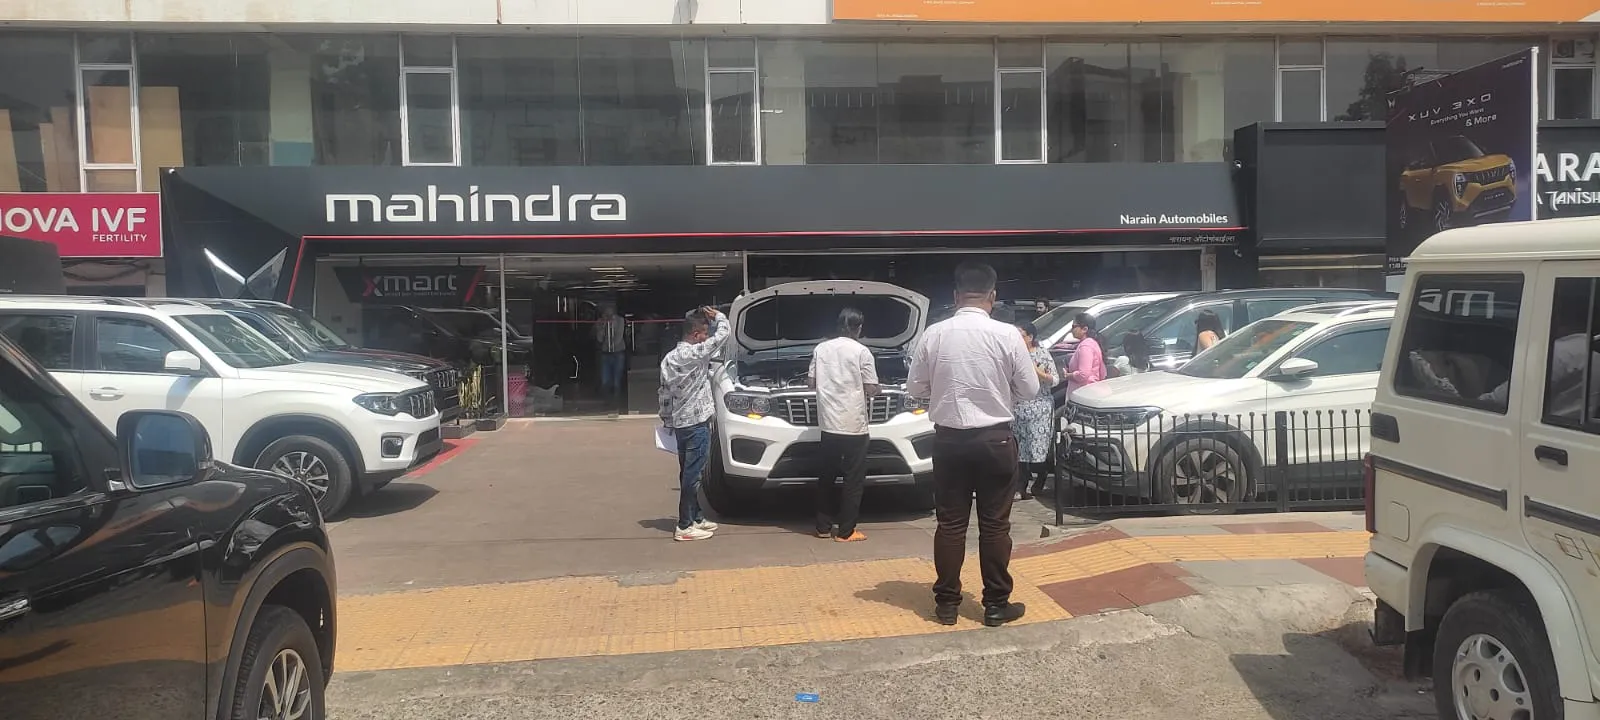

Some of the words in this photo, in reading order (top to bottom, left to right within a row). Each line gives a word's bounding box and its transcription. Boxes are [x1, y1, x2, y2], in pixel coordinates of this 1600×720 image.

[1408, 107, 1441, 122] XUV
[1452, 93, 1491, 110] 3XO
[1430, 114, 1458, 126] Everything
[1465, 119, 1473, 127] &
[1474, 114, 1497, 125] More
[325, 184, 627, 223] mahindra
[0, 207, 80, 233] OVA
[92, 207, 148, 233] IVF
[1120, 213, 1157, 225] Narain
[1159, 213, 1228, 225] Automobiles
[92, 234, 148, 243] FERTILITY
[362, 273, 458, 297] xmart
